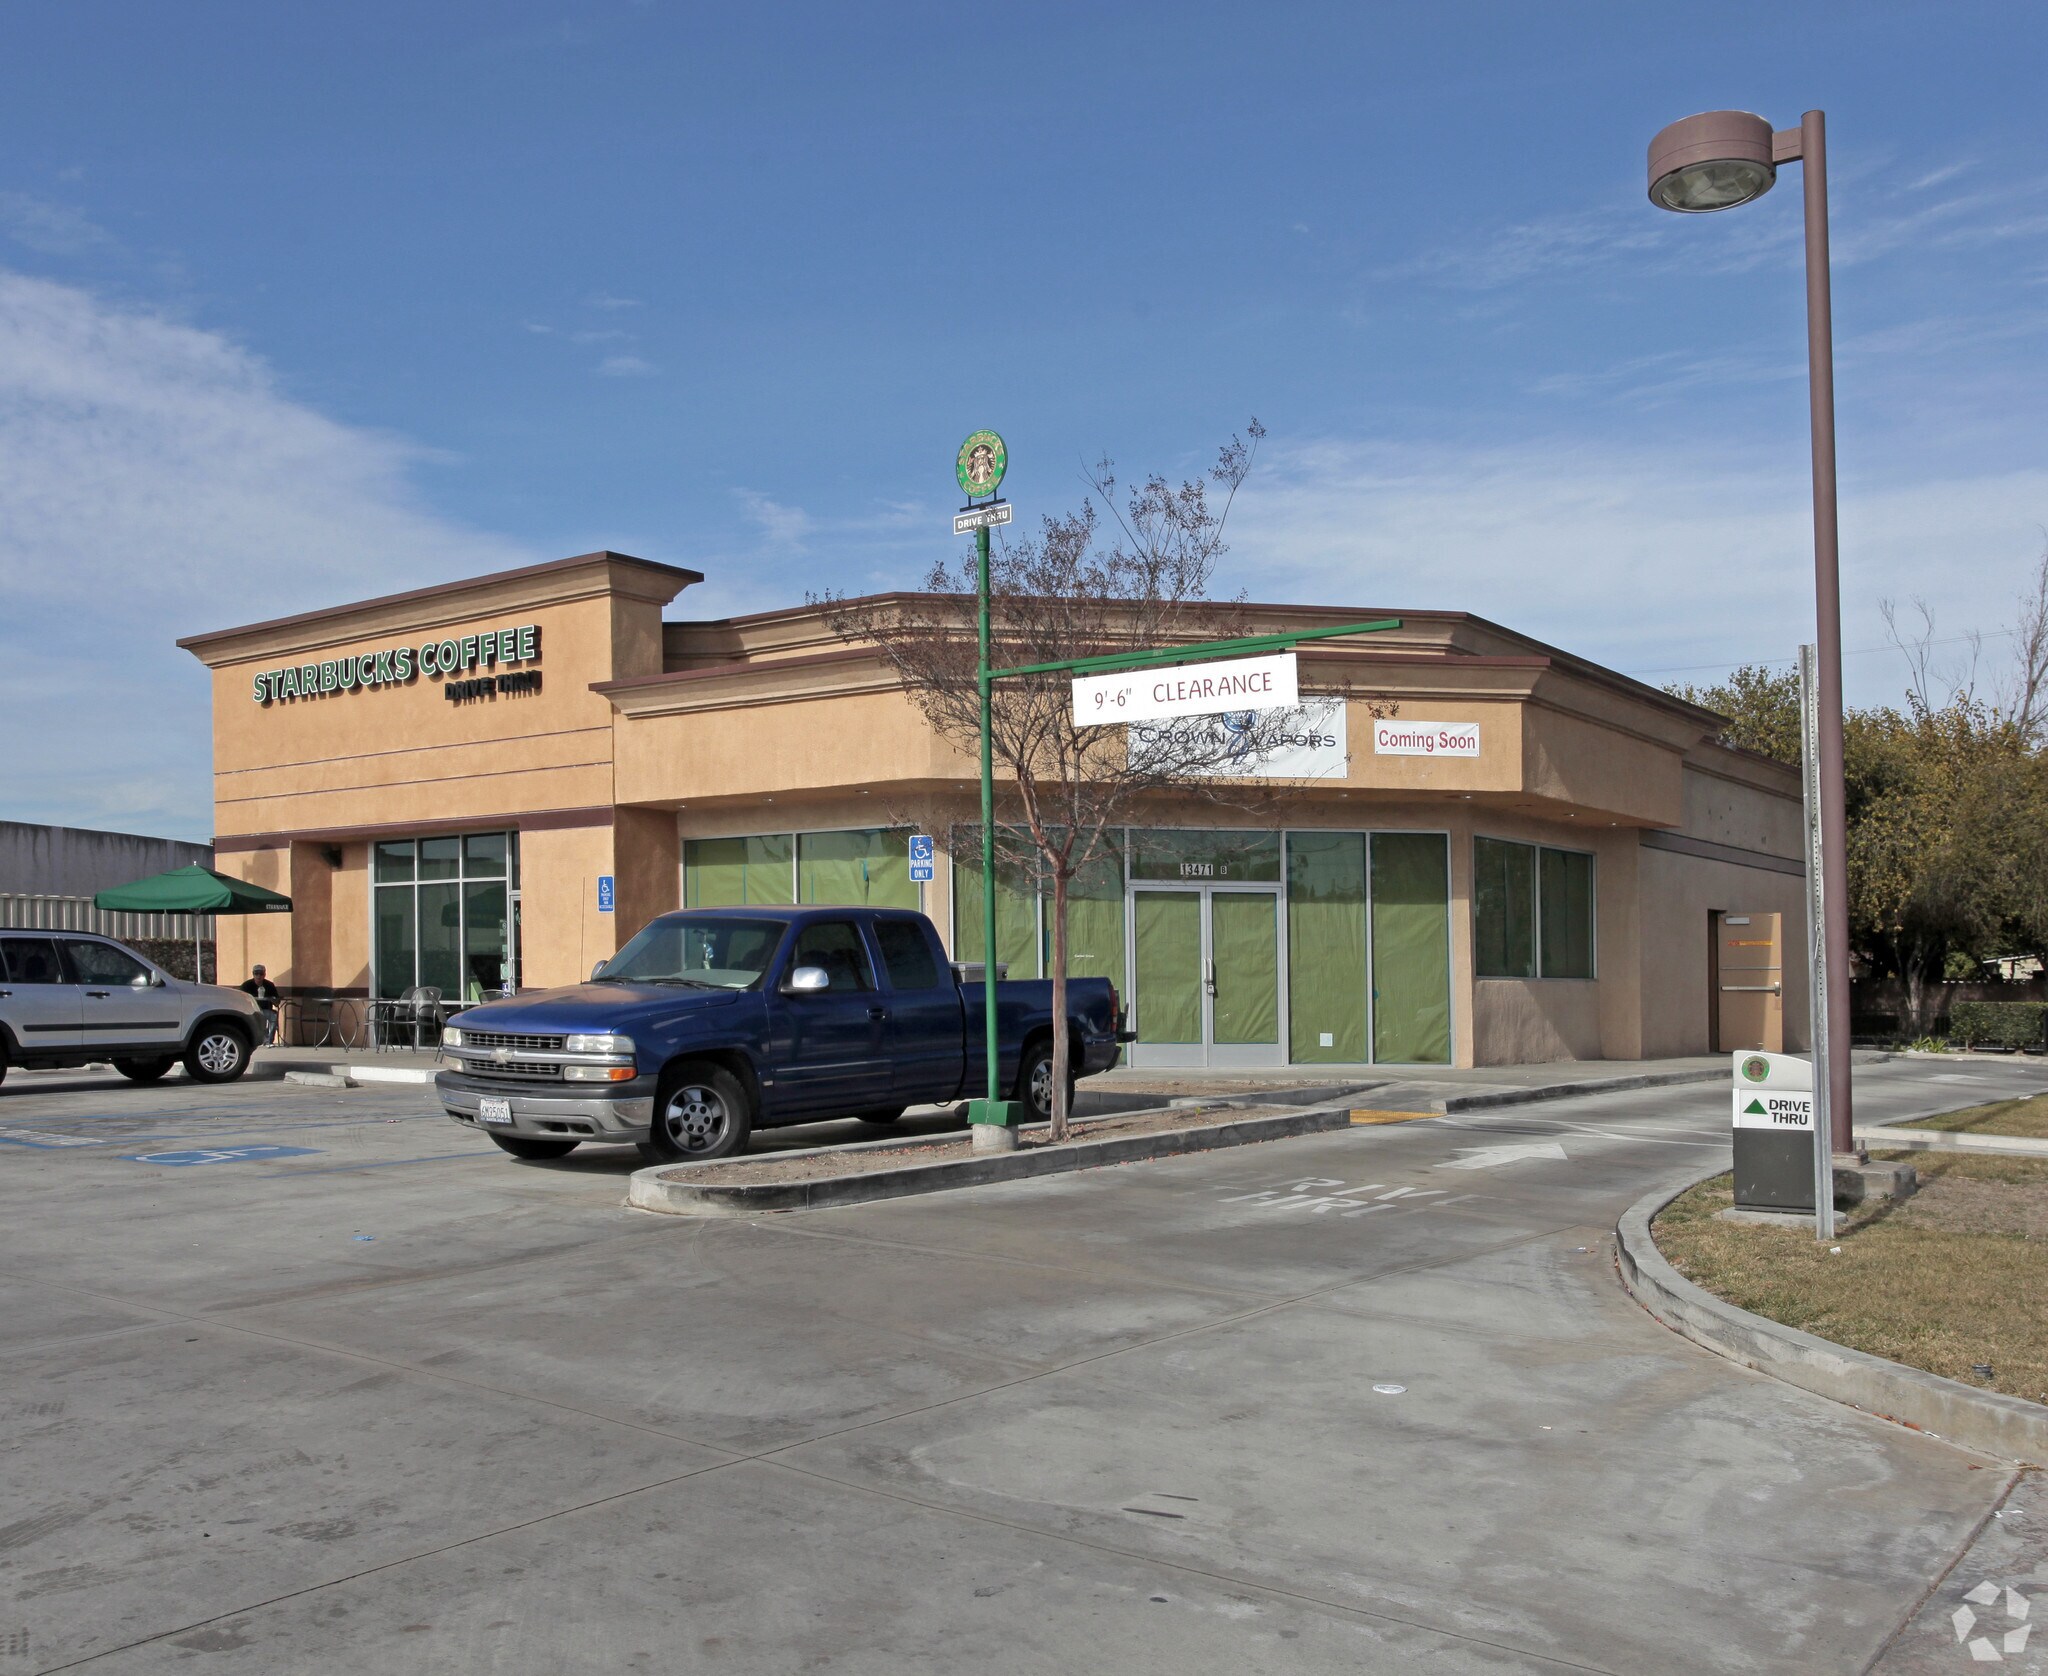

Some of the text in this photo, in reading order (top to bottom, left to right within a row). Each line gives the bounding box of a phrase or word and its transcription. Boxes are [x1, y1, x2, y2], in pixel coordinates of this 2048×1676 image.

[957, 510, 1008, 529] DRIVE THRU
[253, 624, 539, 703] STARBUCKS COFFEE
[445, 677, 494, 701] DRIVE
[1152, 671, 1273, 703] CLEARANCE
[1378, 729, 1476, 752] Coming Soon
[910, 859, 932, 868] PARKING
[1181, 864, 1213, 875] 13471
[914, 869, 929, 878] ONLY
[1768, 1099, 1811, 1113] DRIVE
[1771, 1112, 1808, 1126] THRU
